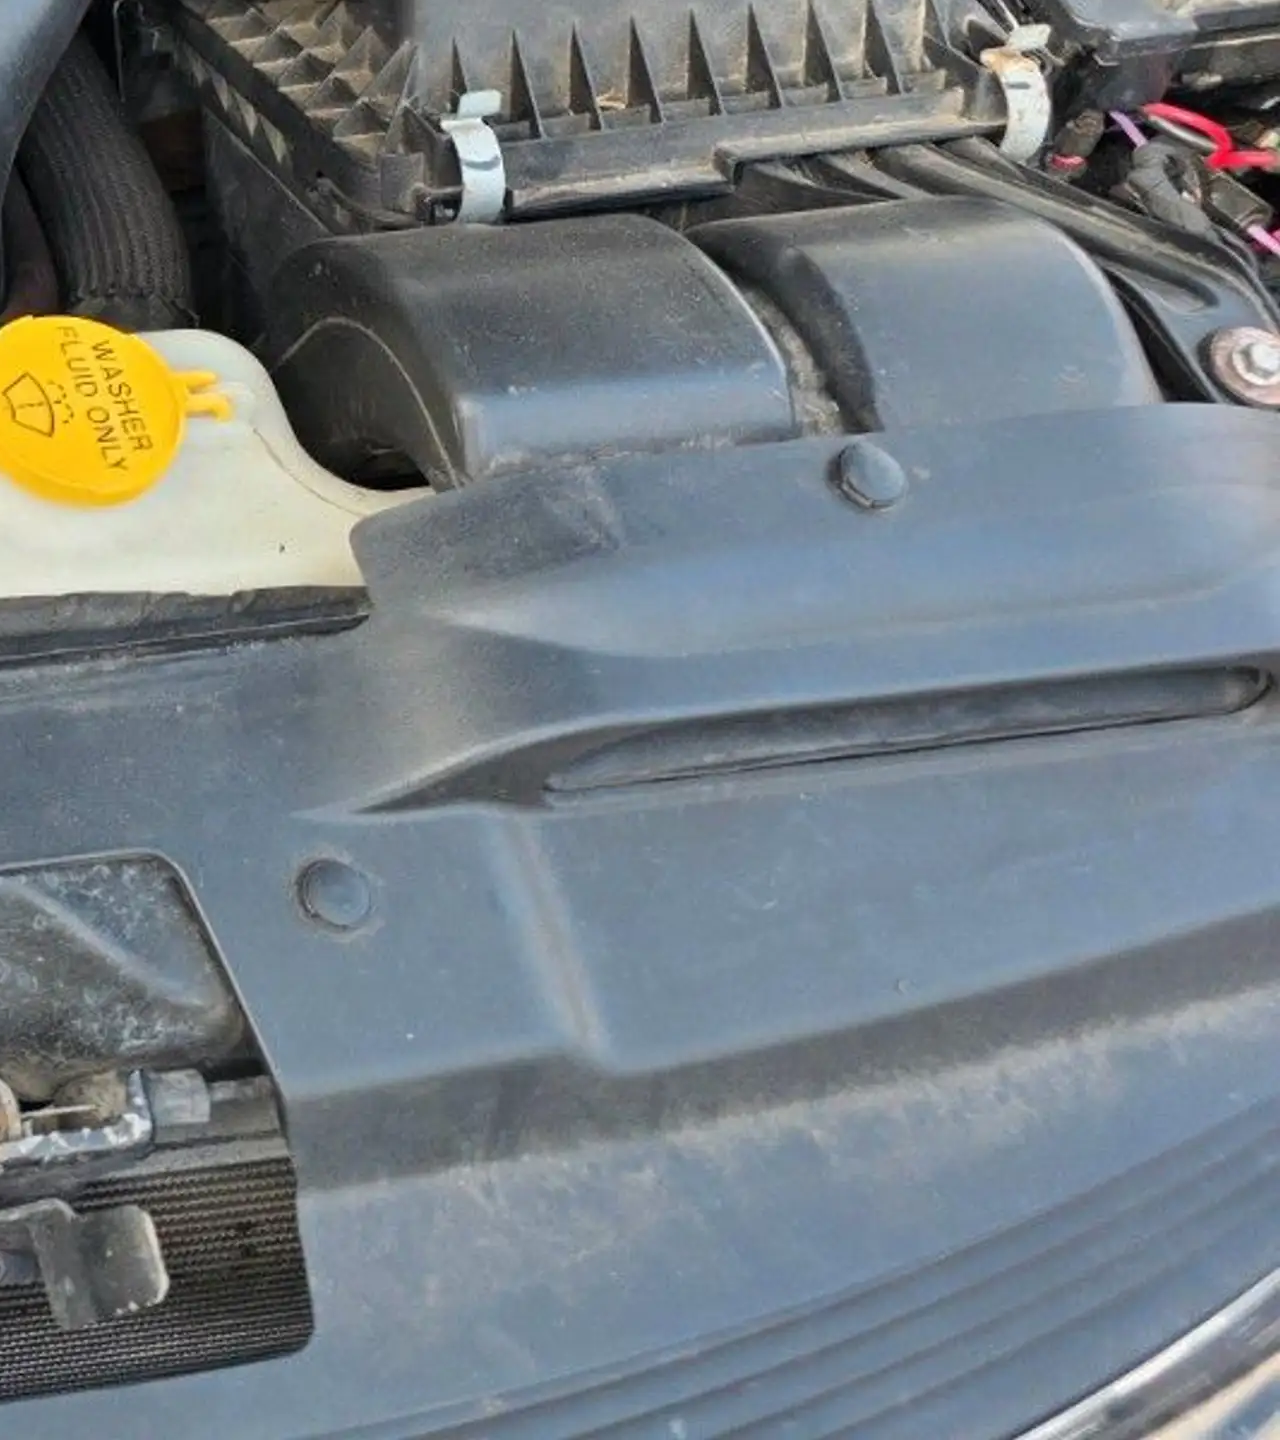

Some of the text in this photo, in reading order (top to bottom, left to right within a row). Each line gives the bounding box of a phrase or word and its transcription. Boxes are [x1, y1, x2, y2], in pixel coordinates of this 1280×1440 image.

[56, 325, 130, 472] FLUID ONLY
[90, 340, 154, 452] WASHER
